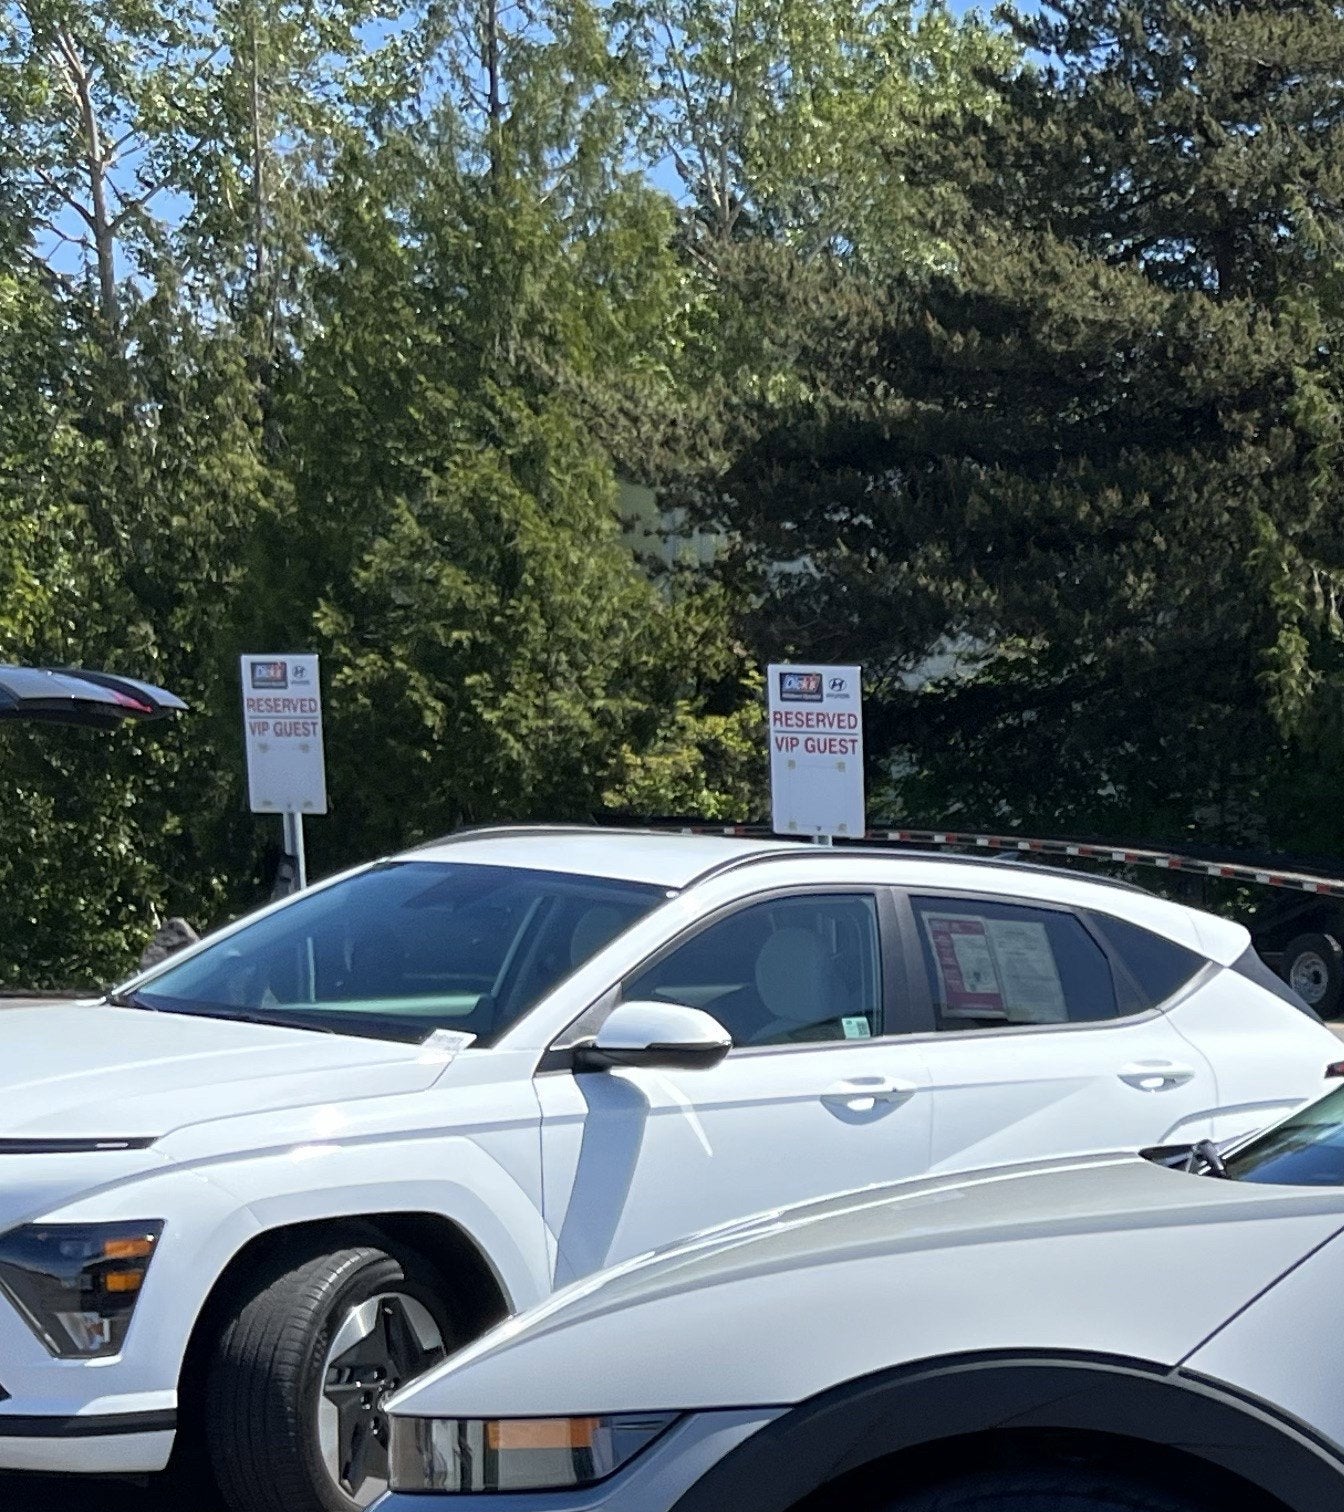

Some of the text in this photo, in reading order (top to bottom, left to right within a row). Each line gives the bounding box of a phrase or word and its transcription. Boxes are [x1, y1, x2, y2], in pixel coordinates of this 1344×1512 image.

[247, 697, 318, 713] RESERVED
[773, 711, 858, 729] RESERVED
[249, 721, 318, 737] VIP GUEST
[775, 736, 858, 755] VIP GUEST
